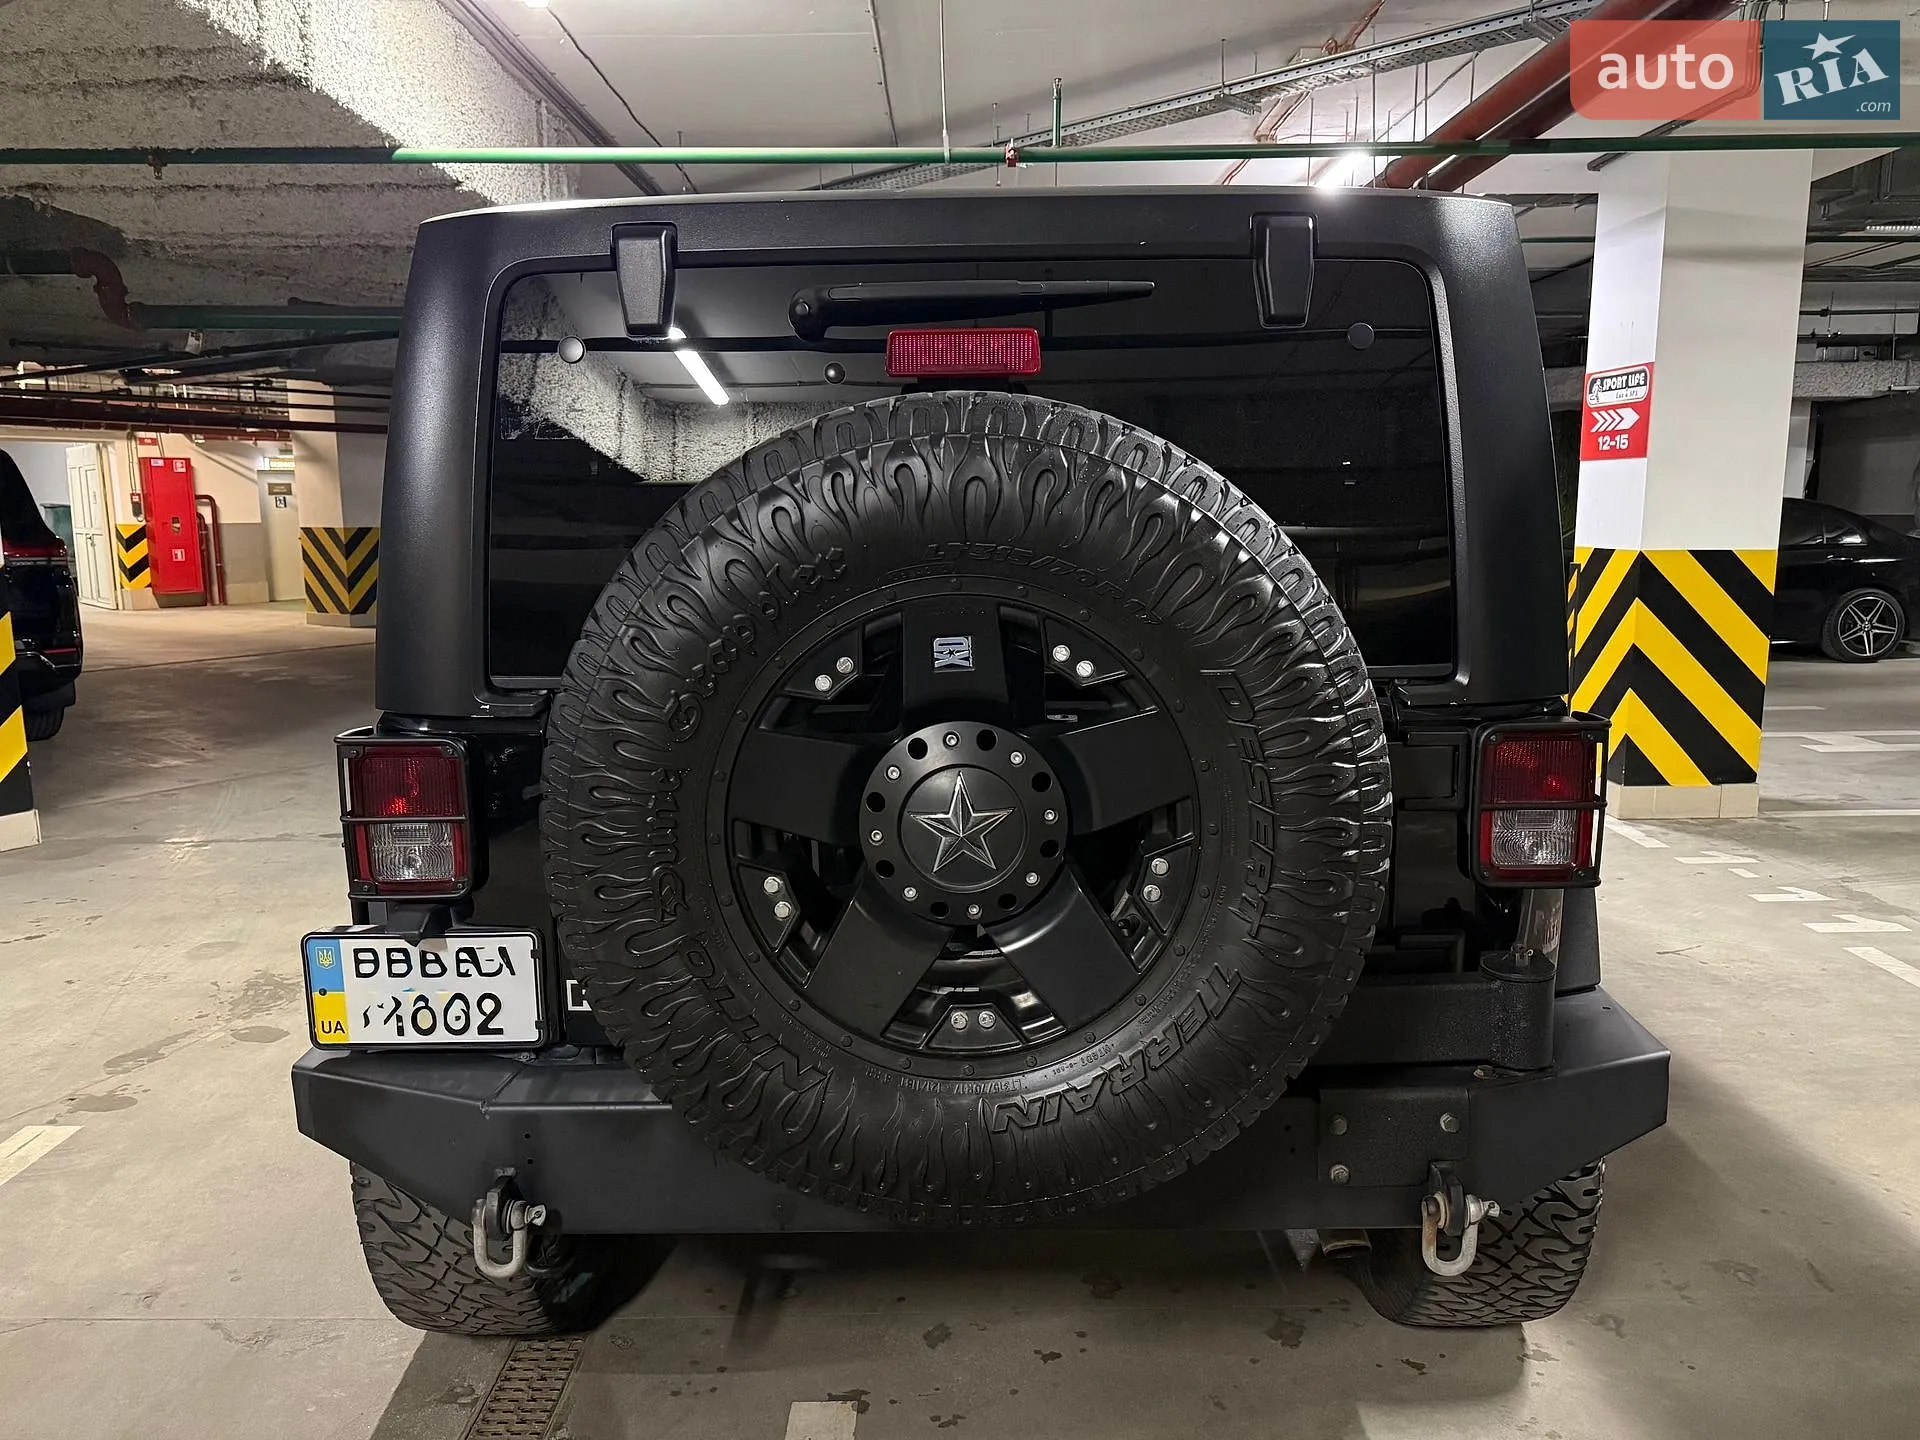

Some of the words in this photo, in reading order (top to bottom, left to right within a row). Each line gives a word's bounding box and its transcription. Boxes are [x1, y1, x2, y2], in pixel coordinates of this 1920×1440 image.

[1603, 375, 1628, 391] SPORT
[1597, 433, 1629, 451] 12-15
[1201, 668, 1277, 938] DESERT
[321, 1020, 346, 1035] UA
[682, 934, 830, 1092] NITTO
[993, 962, 1245, 1134] TERRAIN
